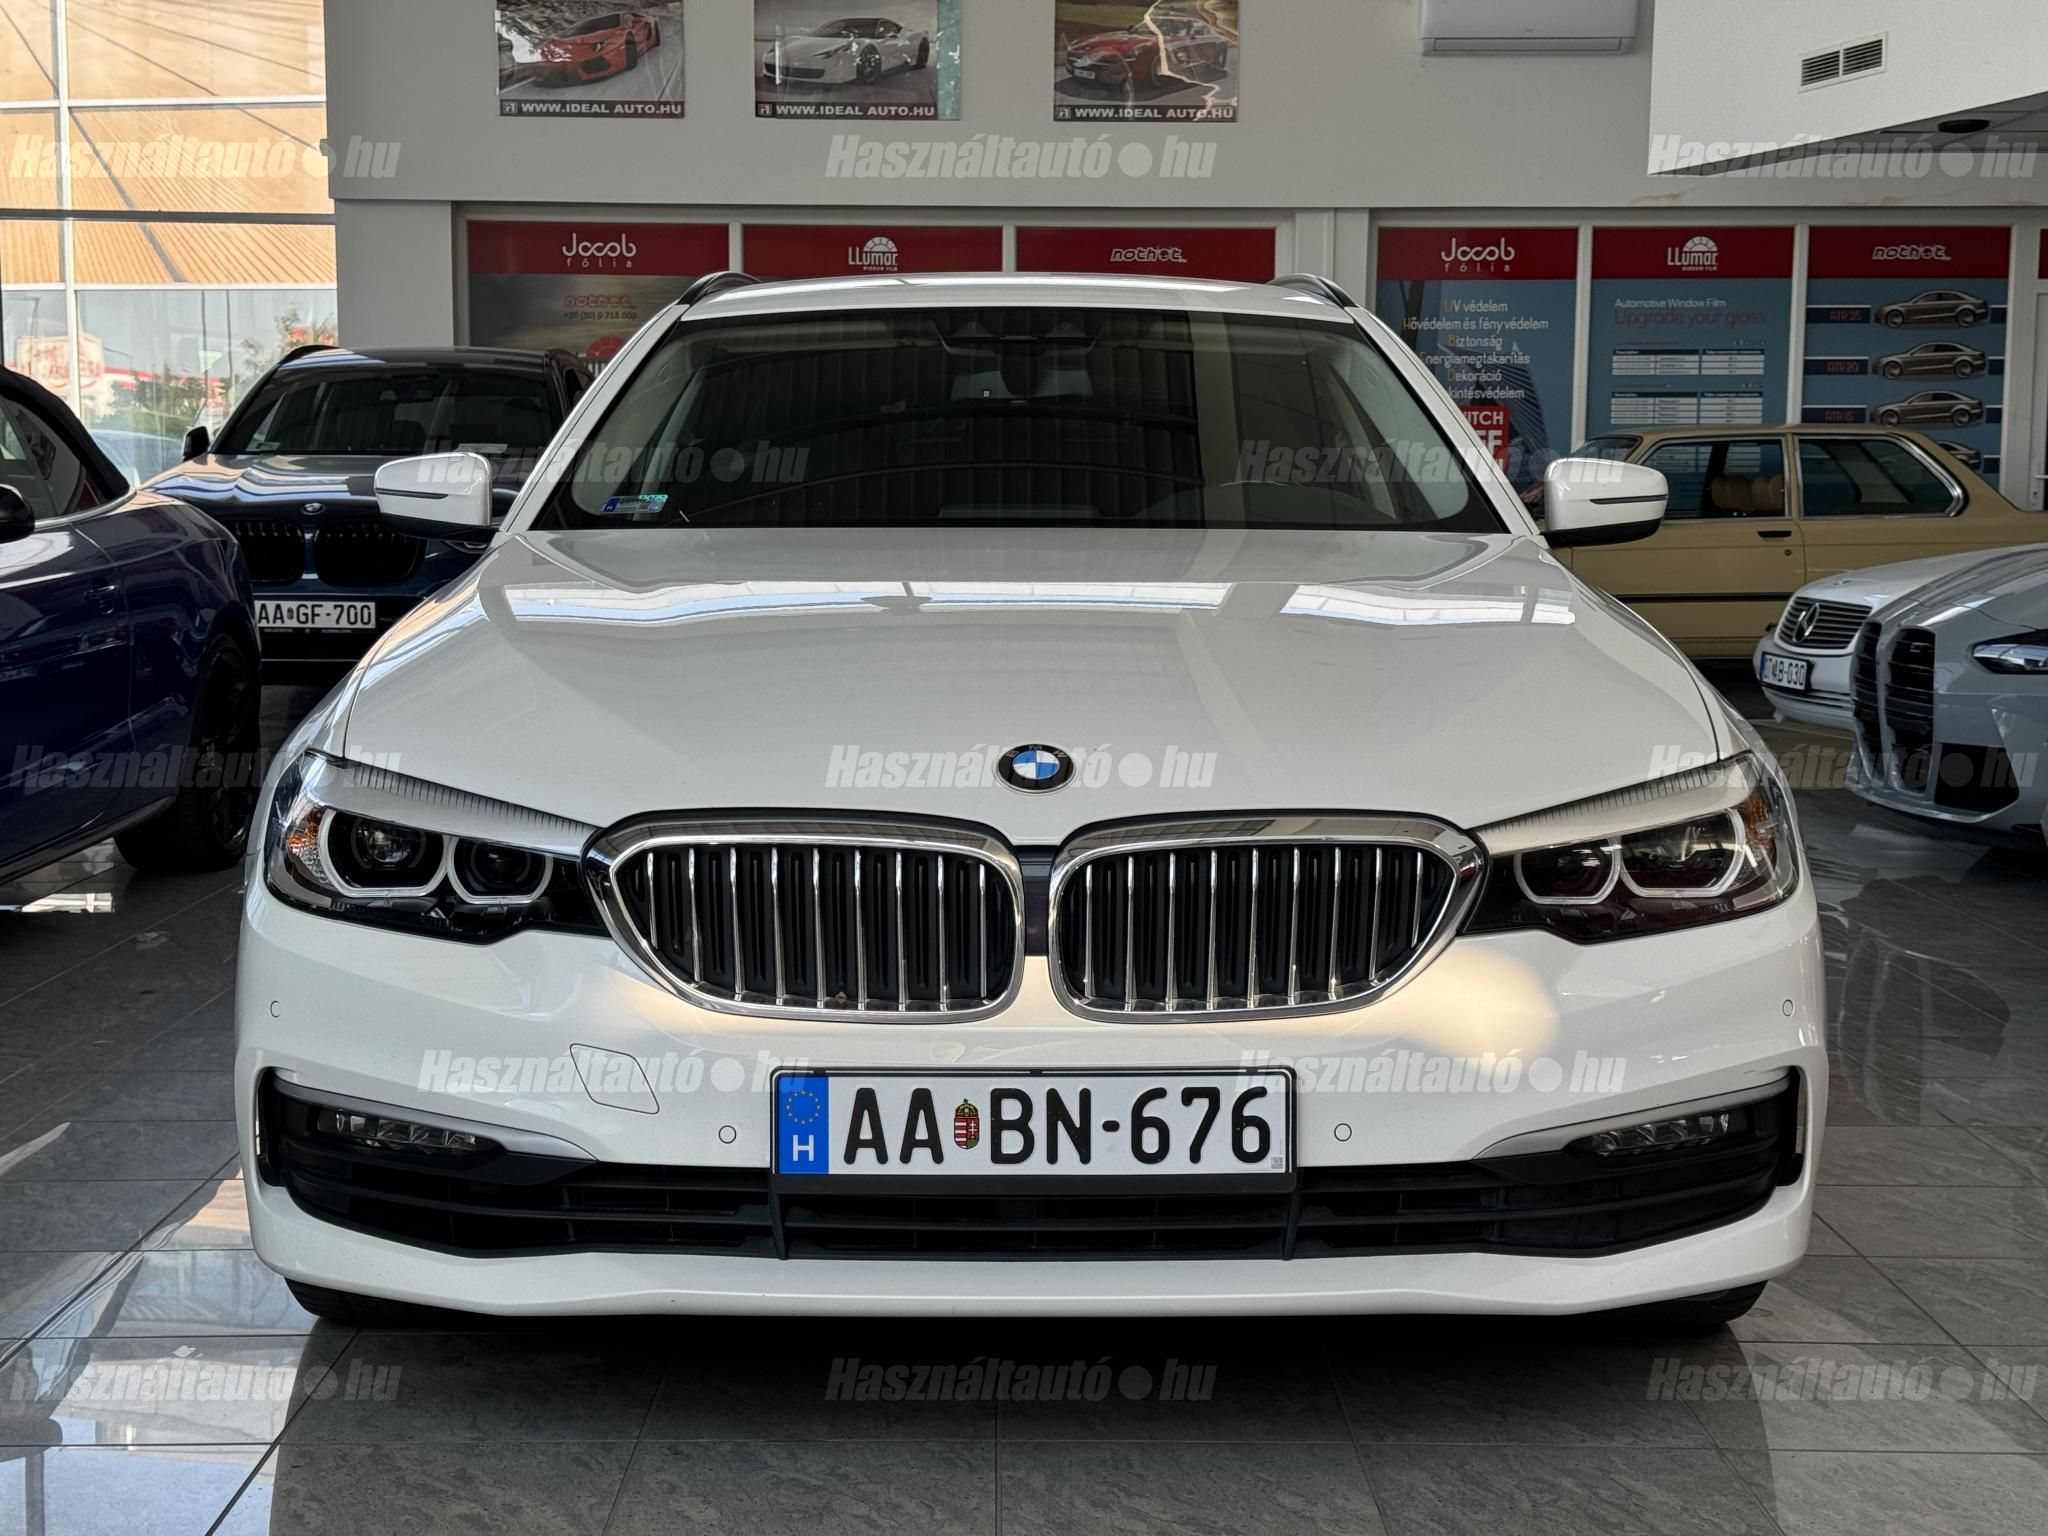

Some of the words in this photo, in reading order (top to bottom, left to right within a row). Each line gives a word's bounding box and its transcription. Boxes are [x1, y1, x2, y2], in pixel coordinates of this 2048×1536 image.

[1445, 301, 1461, 312] UV
[1463, 300, 1508, 312] védelem
[1614, 298, 1666, 308] Automotive
[1668, 298, 1704, 308] Window
[1706, 298, 1726, 308] Film
[1403, 316, 1461, 330] Hővédelem
[1463, 317, 1476, 330] és
[1615, 309, 1682, 328] Upgrade
[1687, 311, 1721, 328] your
[1448, 334, 1503, 351] Biztonság
[1447, 369, 1502, 382] Dekoráció
[1448, 385, 1525, 399] kintésvédelem
[1464, 411, 1504, 425] ITCH
[793, 1135, 815, 1162] H
